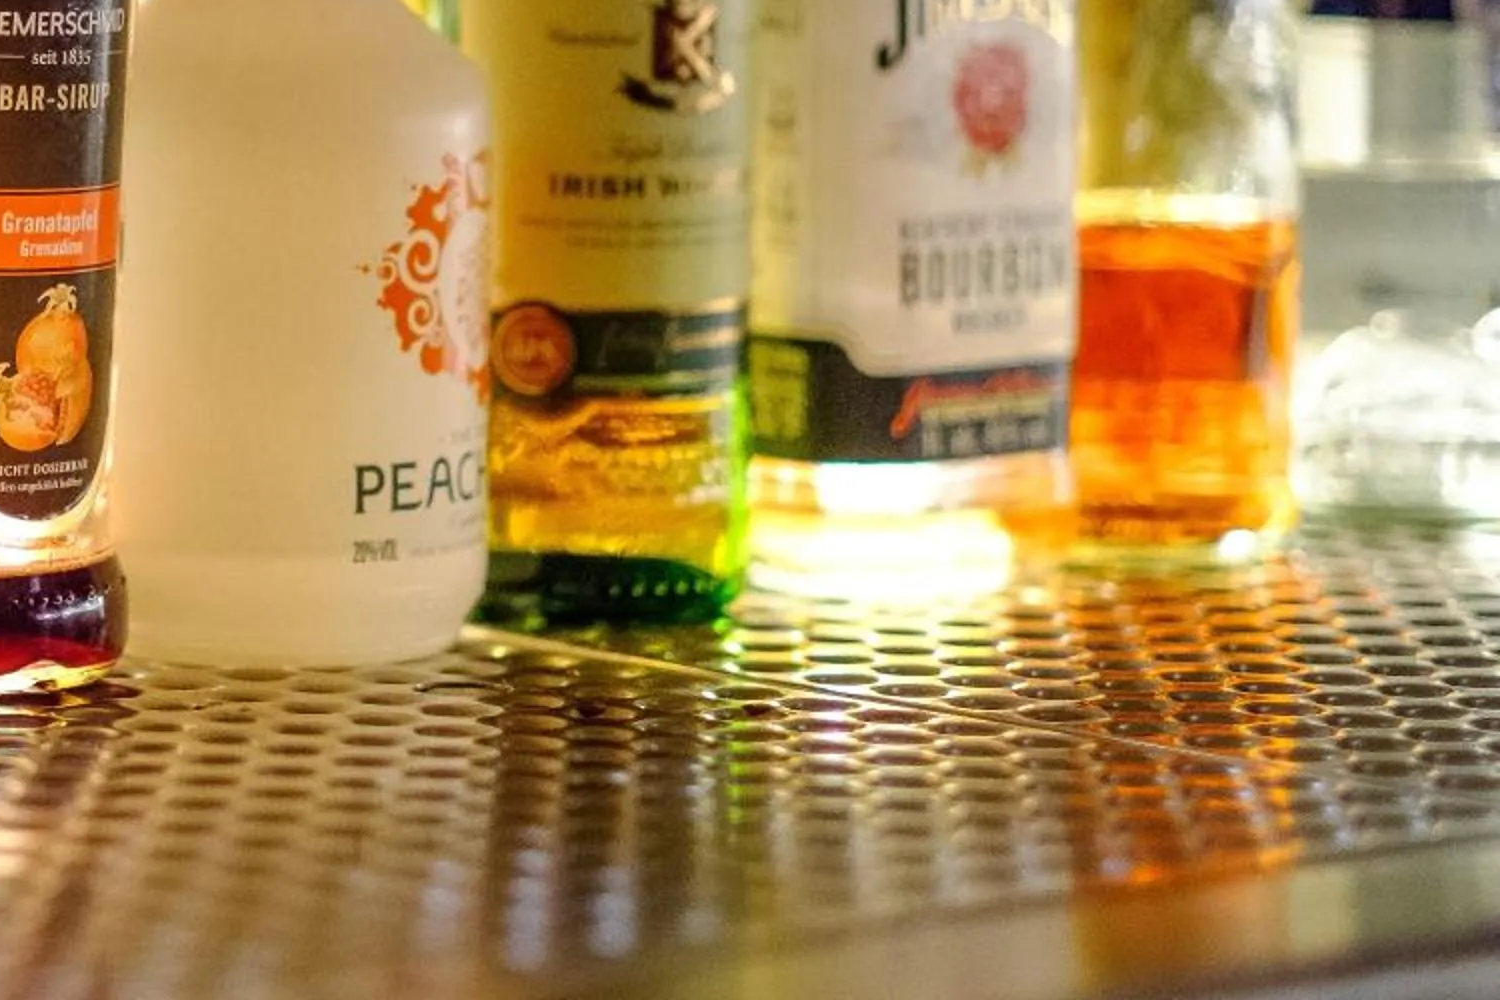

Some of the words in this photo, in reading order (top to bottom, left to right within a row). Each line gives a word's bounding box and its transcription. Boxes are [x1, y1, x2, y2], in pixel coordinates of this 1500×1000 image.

[31, 49, 58, 65] seit
[0, 80, 111, 112] BAR-SIRUP
[2, 209, 99, 236] Granatapfel
